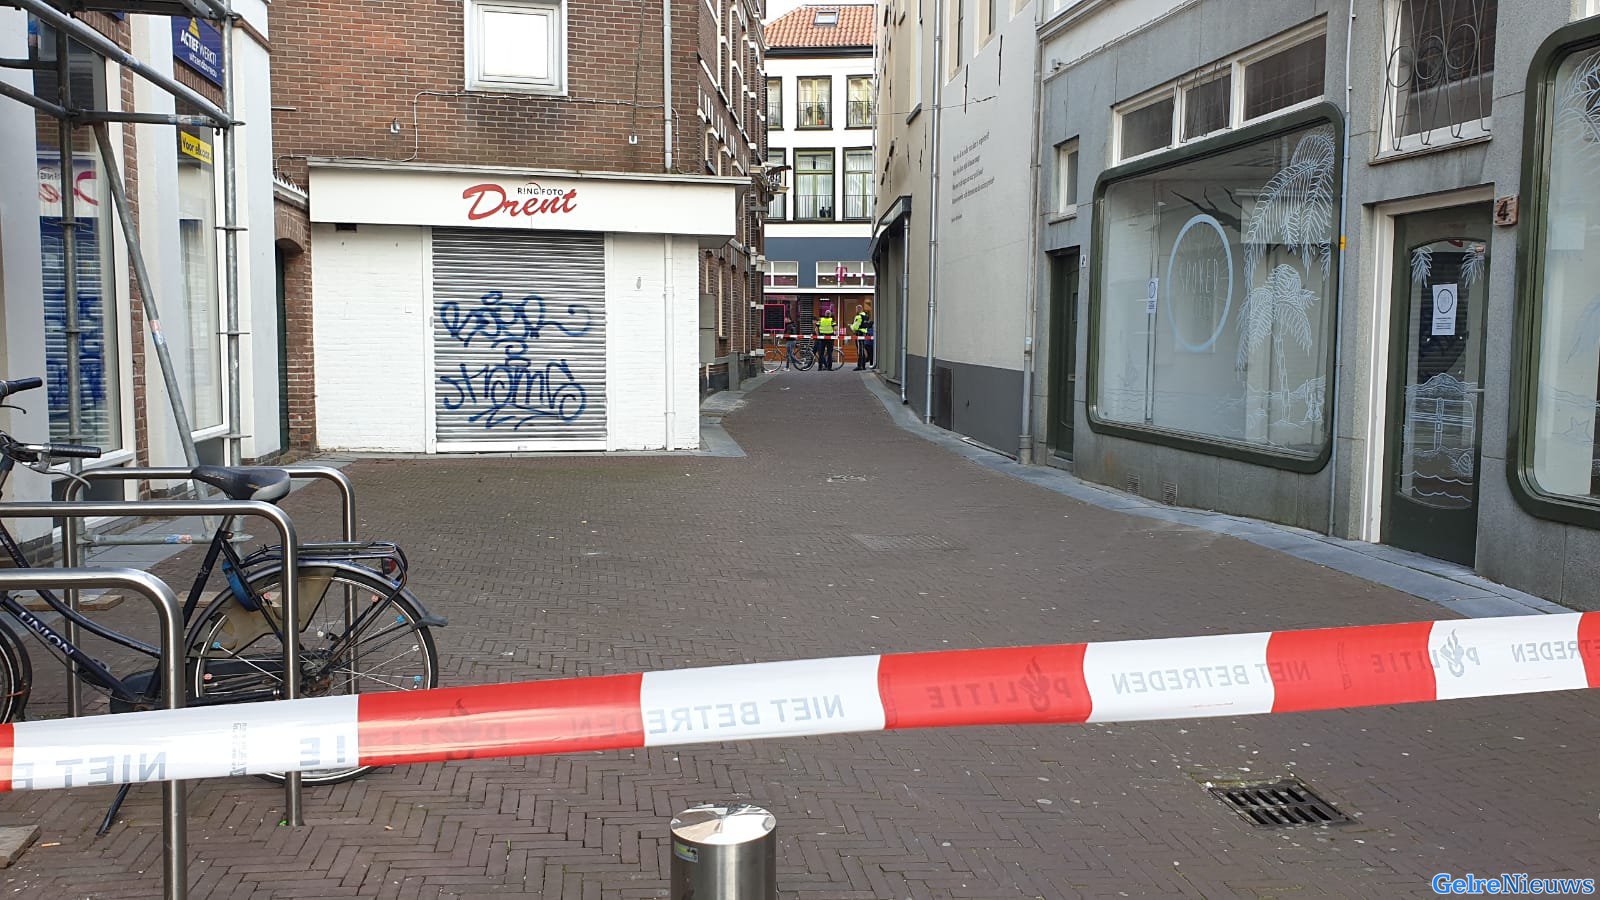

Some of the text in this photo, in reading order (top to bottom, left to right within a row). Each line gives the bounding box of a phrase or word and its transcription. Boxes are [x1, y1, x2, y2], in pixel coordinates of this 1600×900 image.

[180, 29, 200, 53] ACTIEF
[462, 183, 577, 220] Drent
[1496, 201, 1509, 221] 4
[18, 611, 75, 656] UNION
